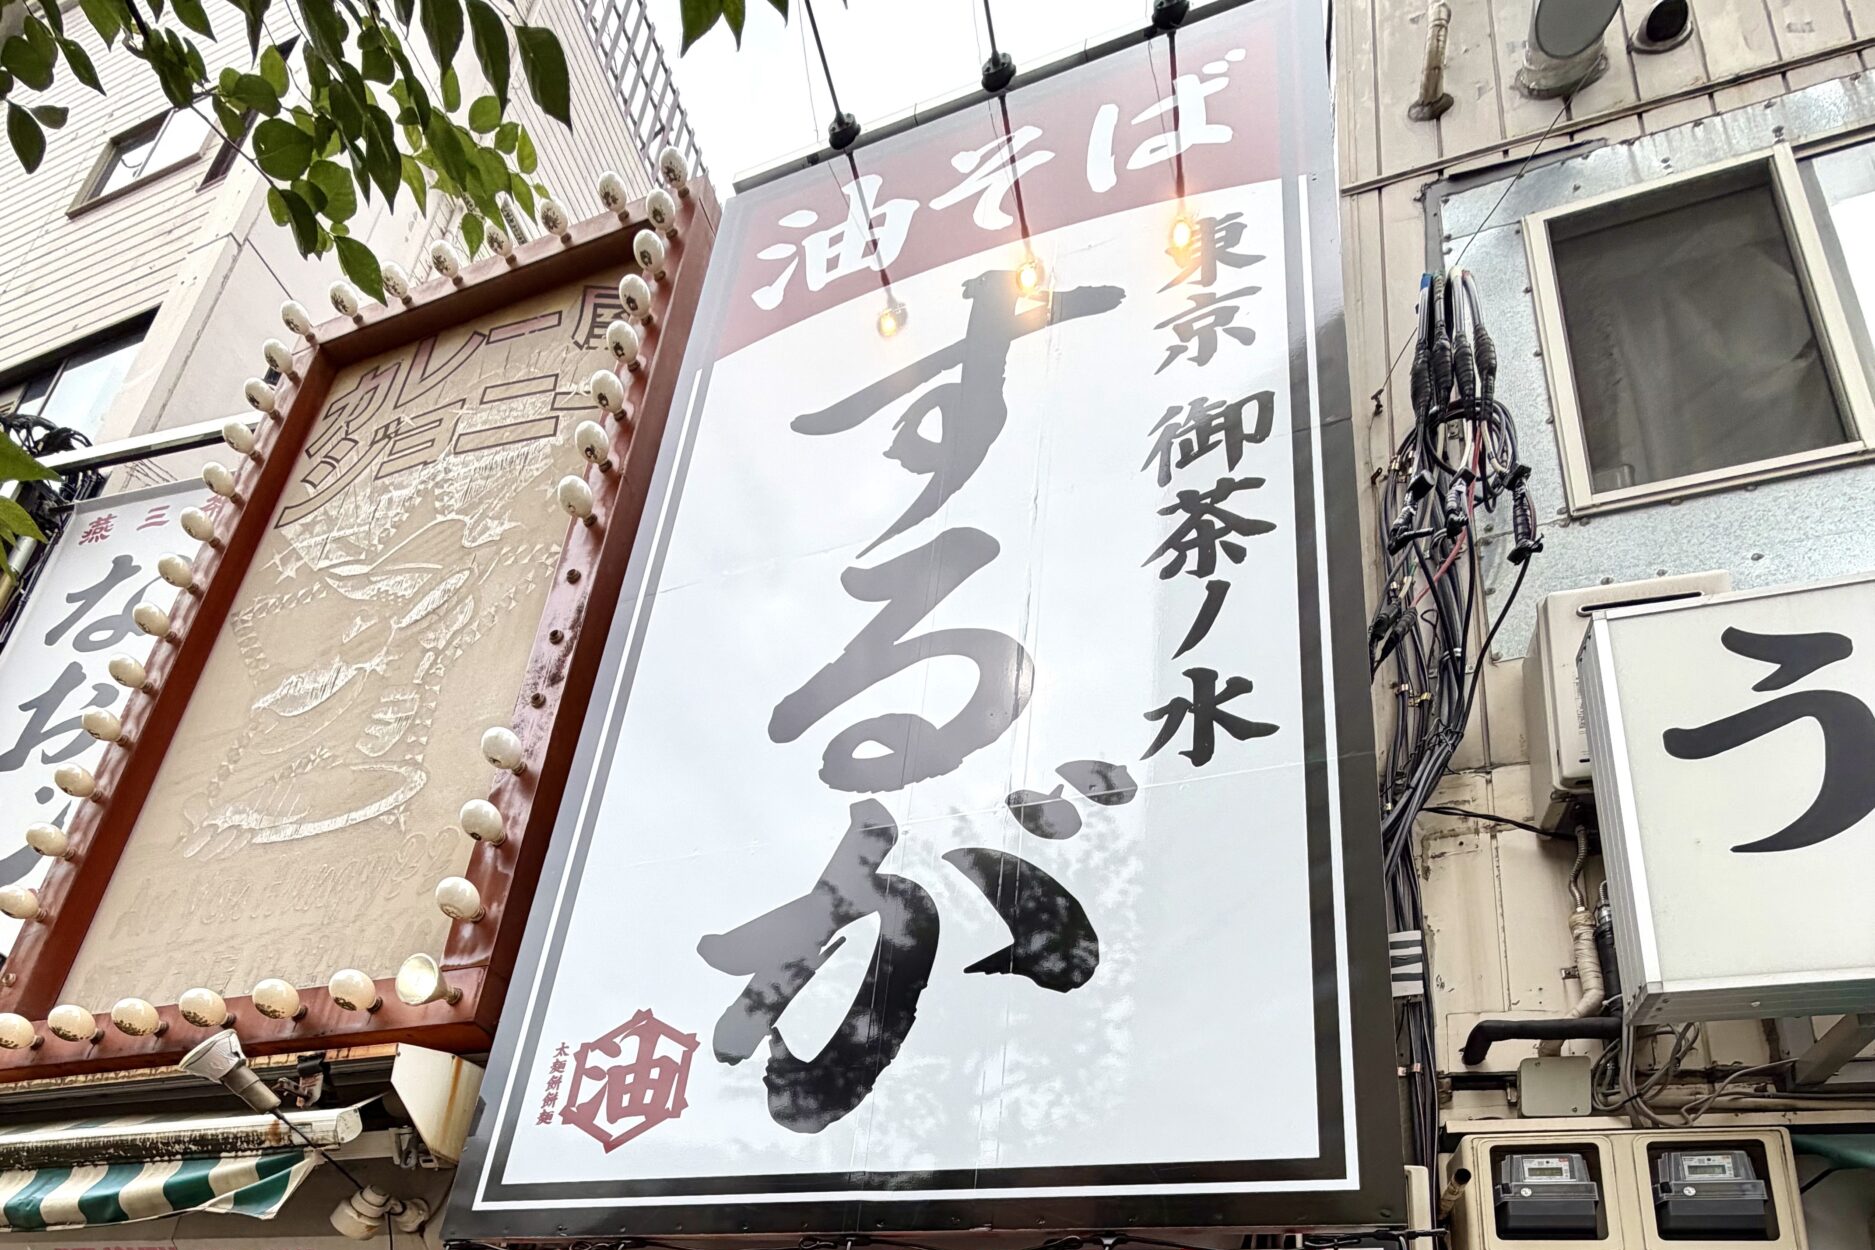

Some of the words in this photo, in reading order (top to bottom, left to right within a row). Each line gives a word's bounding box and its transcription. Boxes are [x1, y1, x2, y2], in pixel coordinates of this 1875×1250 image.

[751, 48, 1246, 309] 油そば
[1153, 211, 1267, 376] 東京
[1139, 390, 1280, 767] 御茶ノ水
[696, 269, 1138, 1134] するが
[1663, 626, 1875, 853] う
[566, 1012, 692, 1140] 油
